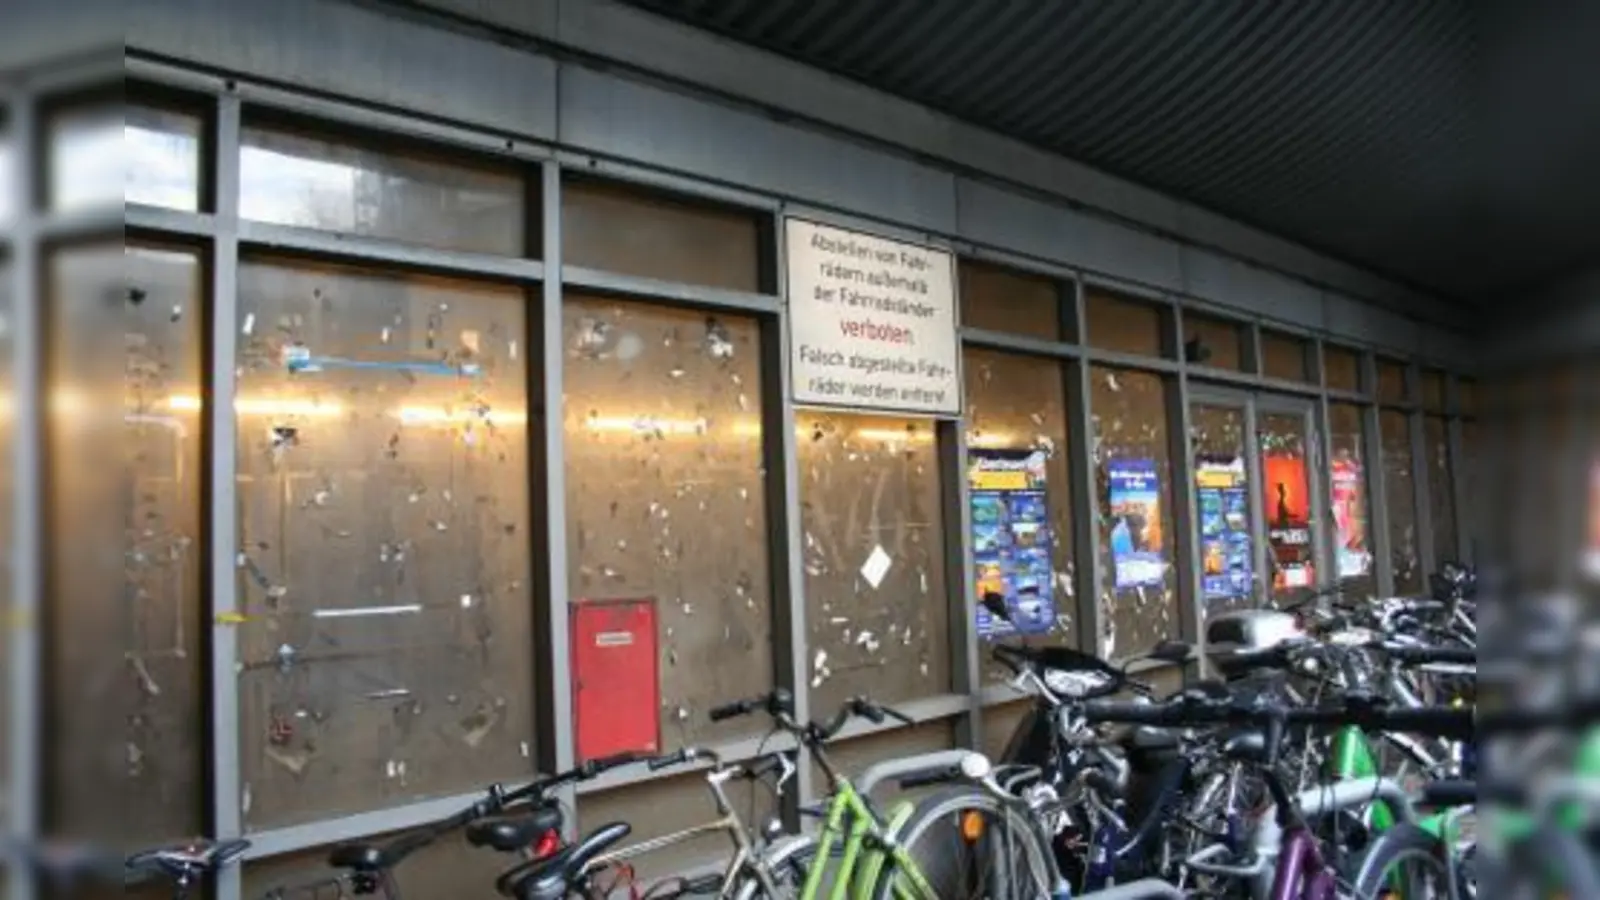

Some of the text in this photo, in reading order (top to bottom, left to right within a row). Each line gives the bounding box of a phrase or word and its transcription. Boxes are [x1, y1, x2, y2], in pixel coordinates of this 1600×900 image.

[811, 233, 933, 269] Abstellen von Fahr-
[814, 286, 836, 301] der
[820, 263, 928, 294] rädern außerhalb
[799, 346, 845, 365] Falsch
[849, 353, 915, 376] abgestellte
[808, 378, 845, 394] räder
[851, 382, 898, 399] werden
